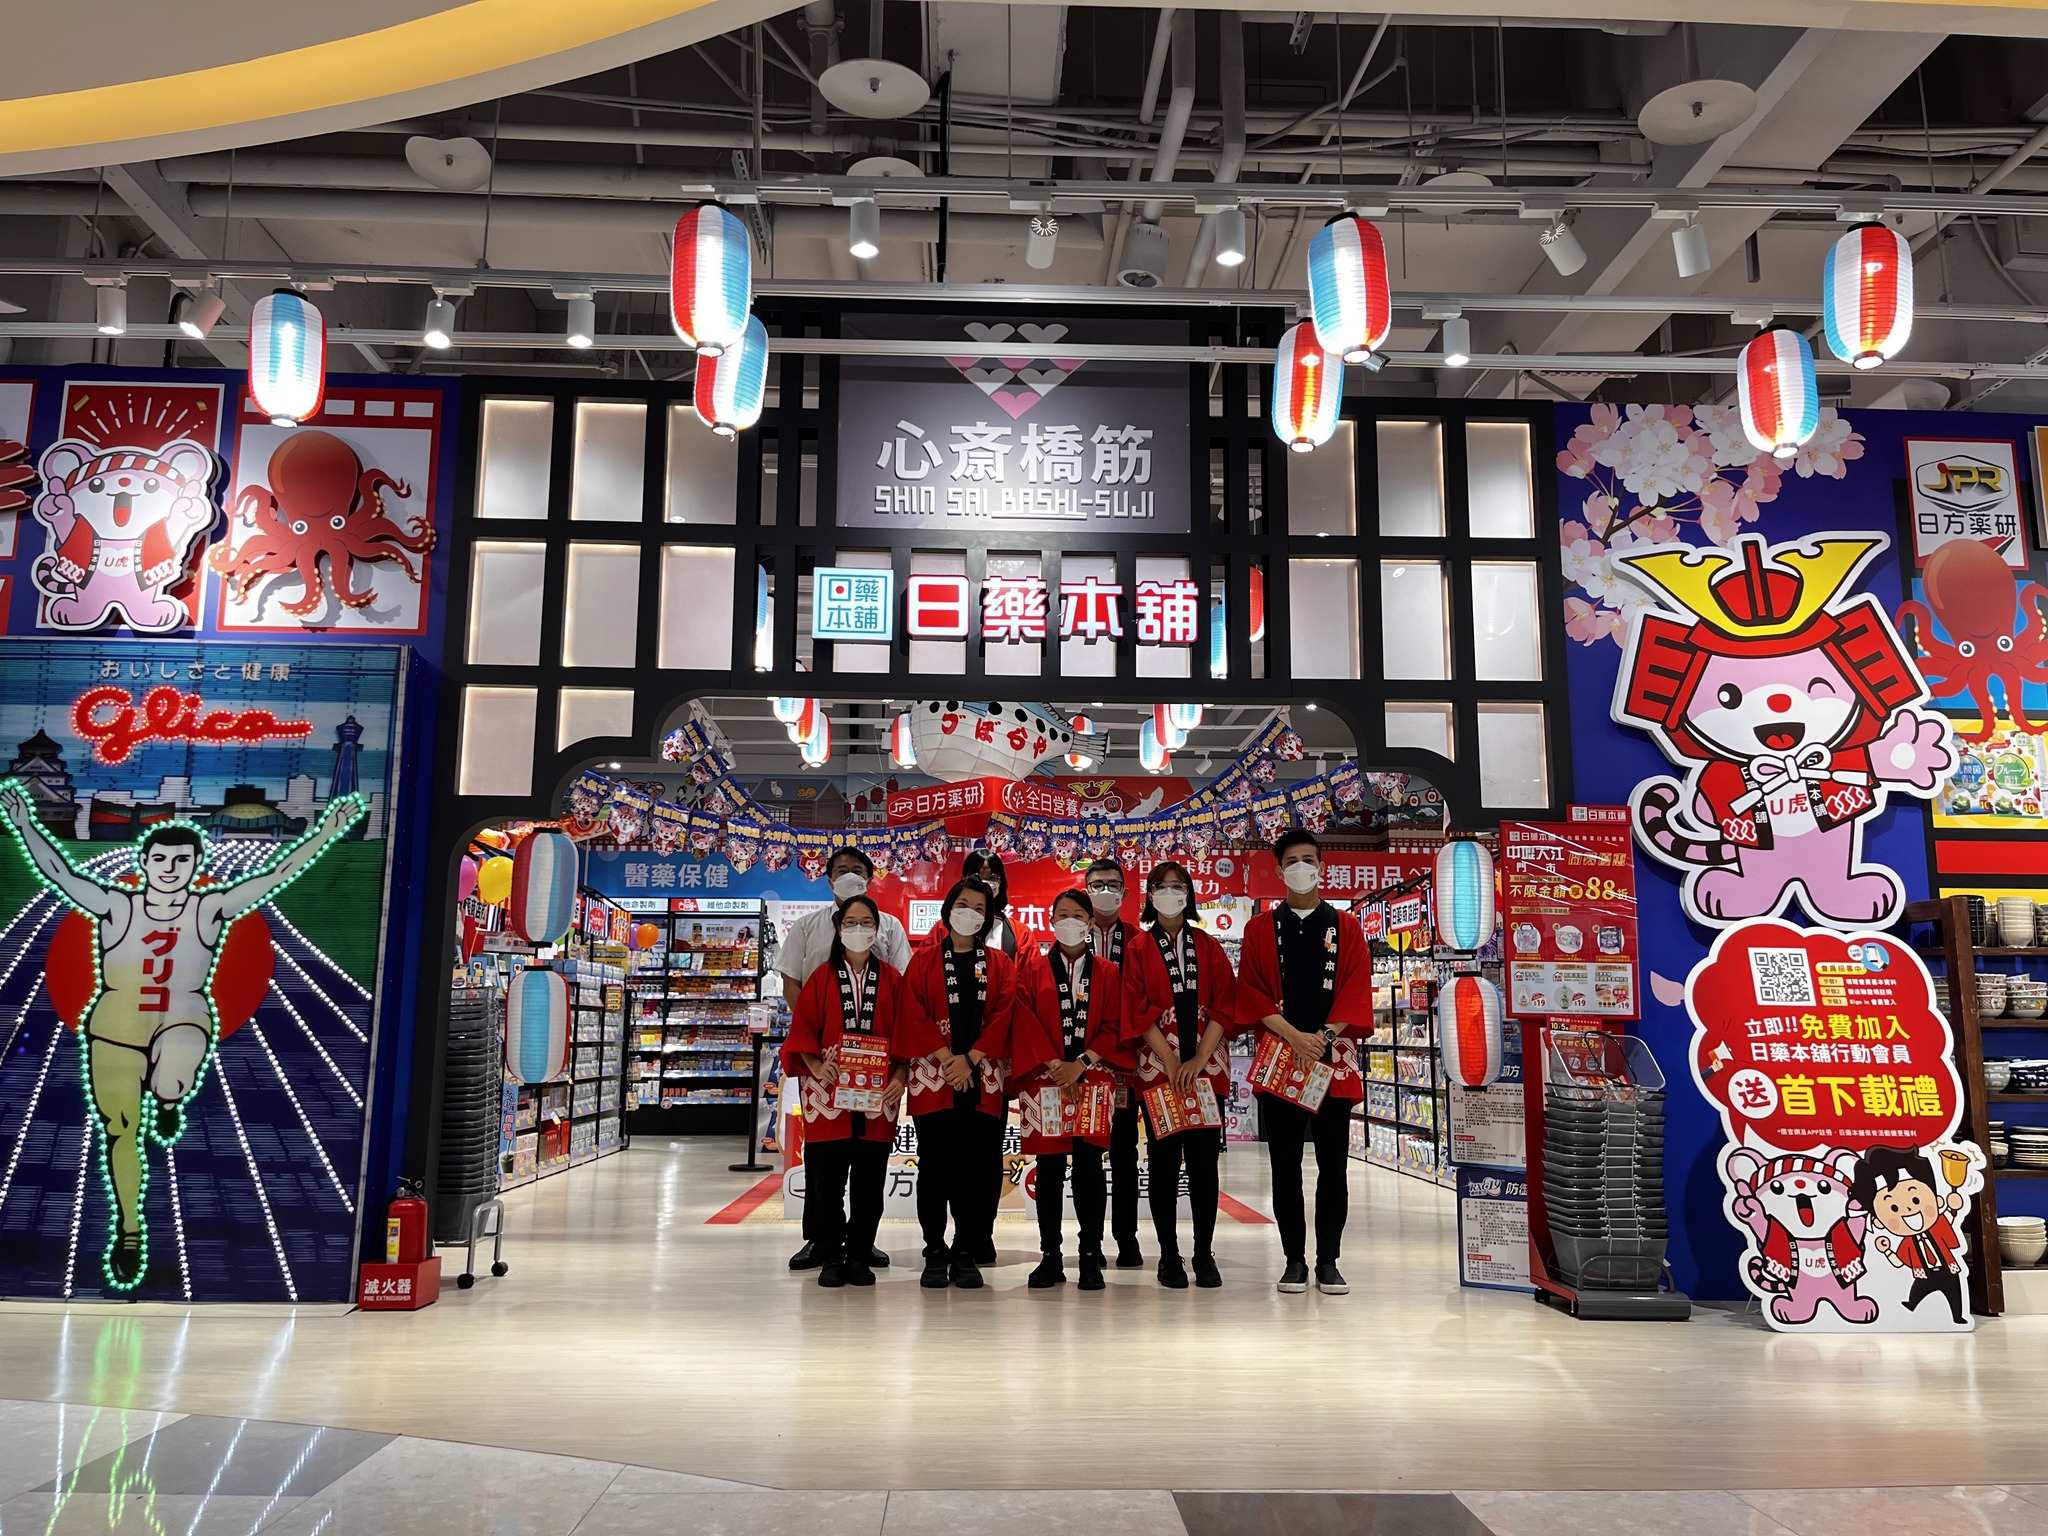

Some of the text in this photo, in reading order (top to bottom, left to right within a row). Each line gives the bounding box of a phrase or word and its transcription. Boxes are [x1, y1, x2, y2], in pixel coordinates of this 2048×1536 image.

[1922, 463, 2003, 491] JPR
[875, 485, 935, 514] SHIN
[947, 487, 989, 516] SAI
[1918, 512, 2017, 535] 日方薬研
[907, 574, 1199, 643] 日藥本舖
[100, 659, 290, 681] おいしさと健康
[1770, 793, 1808, 815] U虎
[624, 863, 730, 889] 醫藥保健
[138, 926, 182, 1013] グリコ
[1751, 1042, 1912, 1065] 日藥本舖行動會員
[1776, 1073, 1944, 1118] 首下載禮
[1805, 1256, 1826, 1269] U虎
[364, 1278, 412, 1295] 滅火器
